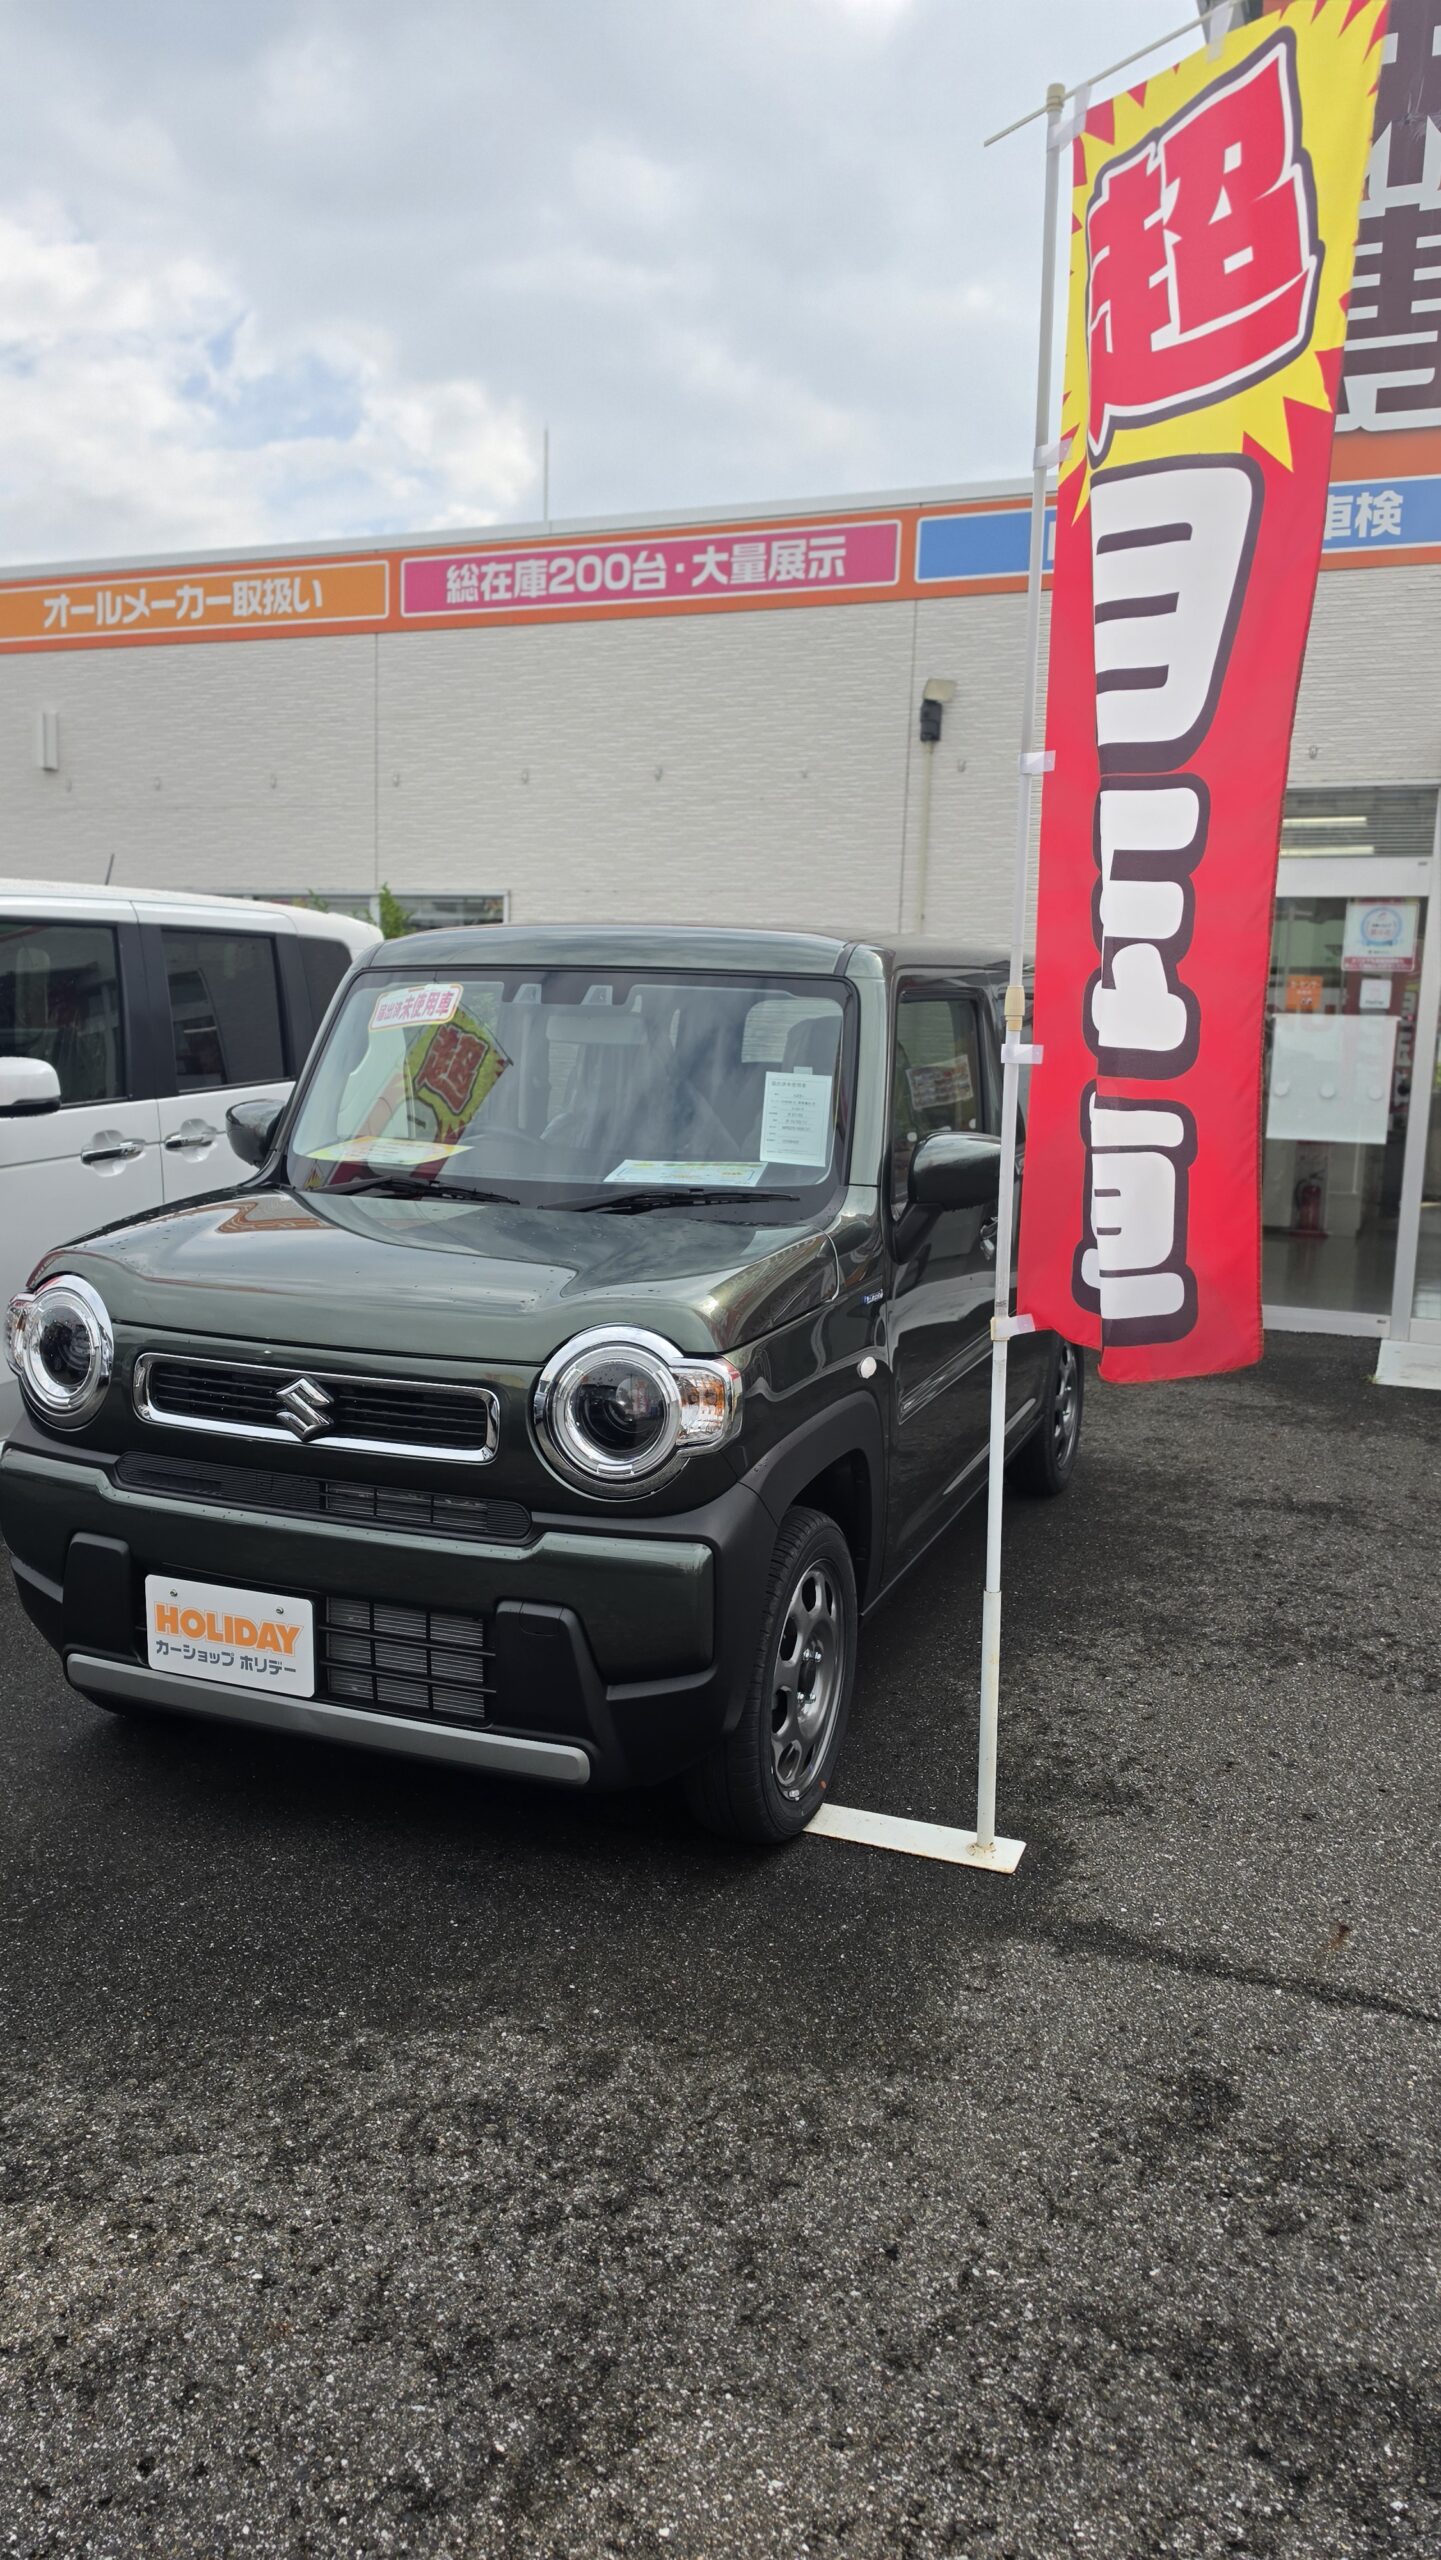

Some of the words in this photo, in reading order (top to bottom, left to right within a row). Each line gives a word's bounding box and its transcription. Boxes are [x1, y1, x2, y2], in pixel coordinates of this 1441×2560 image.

[42, 577, 324, 629] オールメーカー取扱い
[155, 1603, 303, 1656] HOLIDAY
[156, 1640, 235, 1667] カーショップ
[239, 1655, 297, 1675] ホリデー
